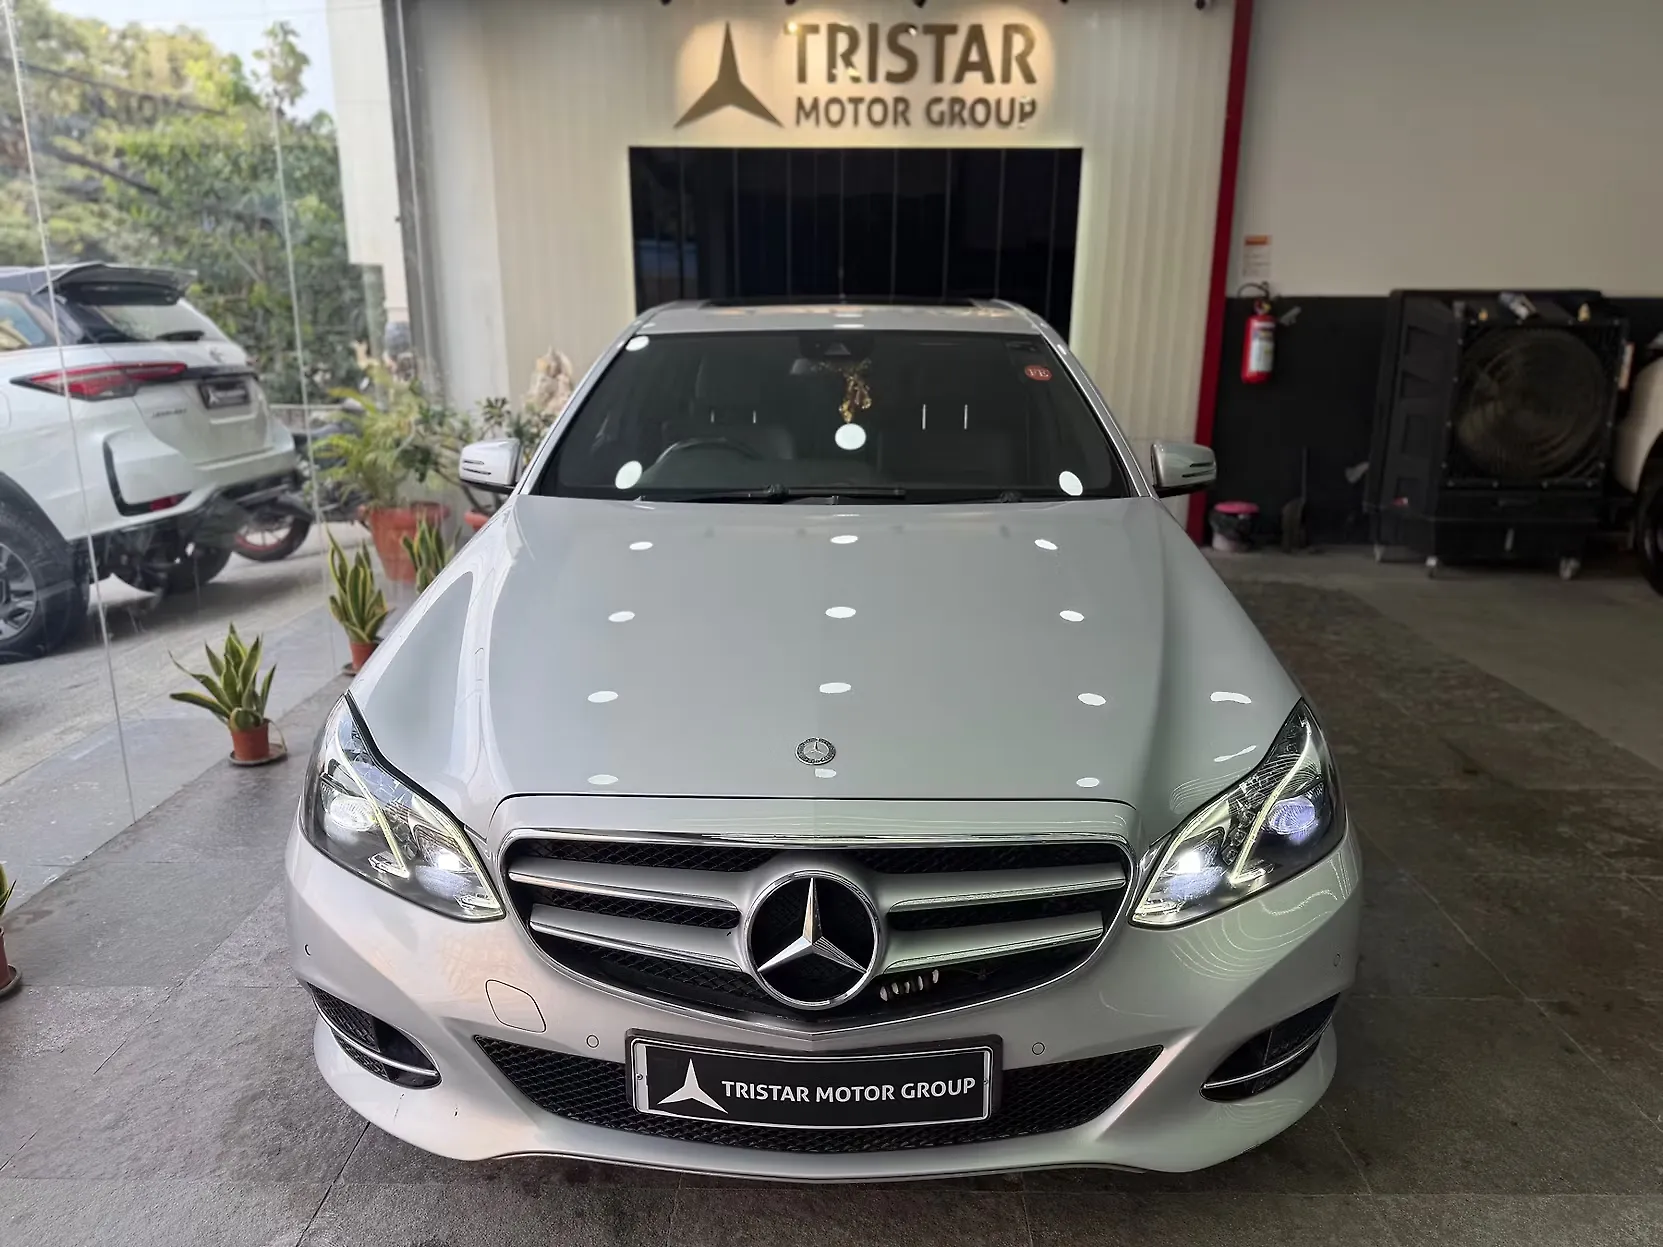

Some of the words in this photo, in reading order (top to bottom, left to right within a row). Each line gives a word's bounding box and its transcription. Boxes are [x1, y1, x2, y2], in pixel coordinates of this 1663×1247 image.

[784, 23, 1037, 84] TRISTAR
[796, 96, 909, 128] MOTOR
[926, 96, 1036, 128] GROUP
[721, 1080, 809, 1102] TRISTAR
[816, 1084, 894, 1103] MOTOR
[901, 1077, 976, 1099] GROUP
